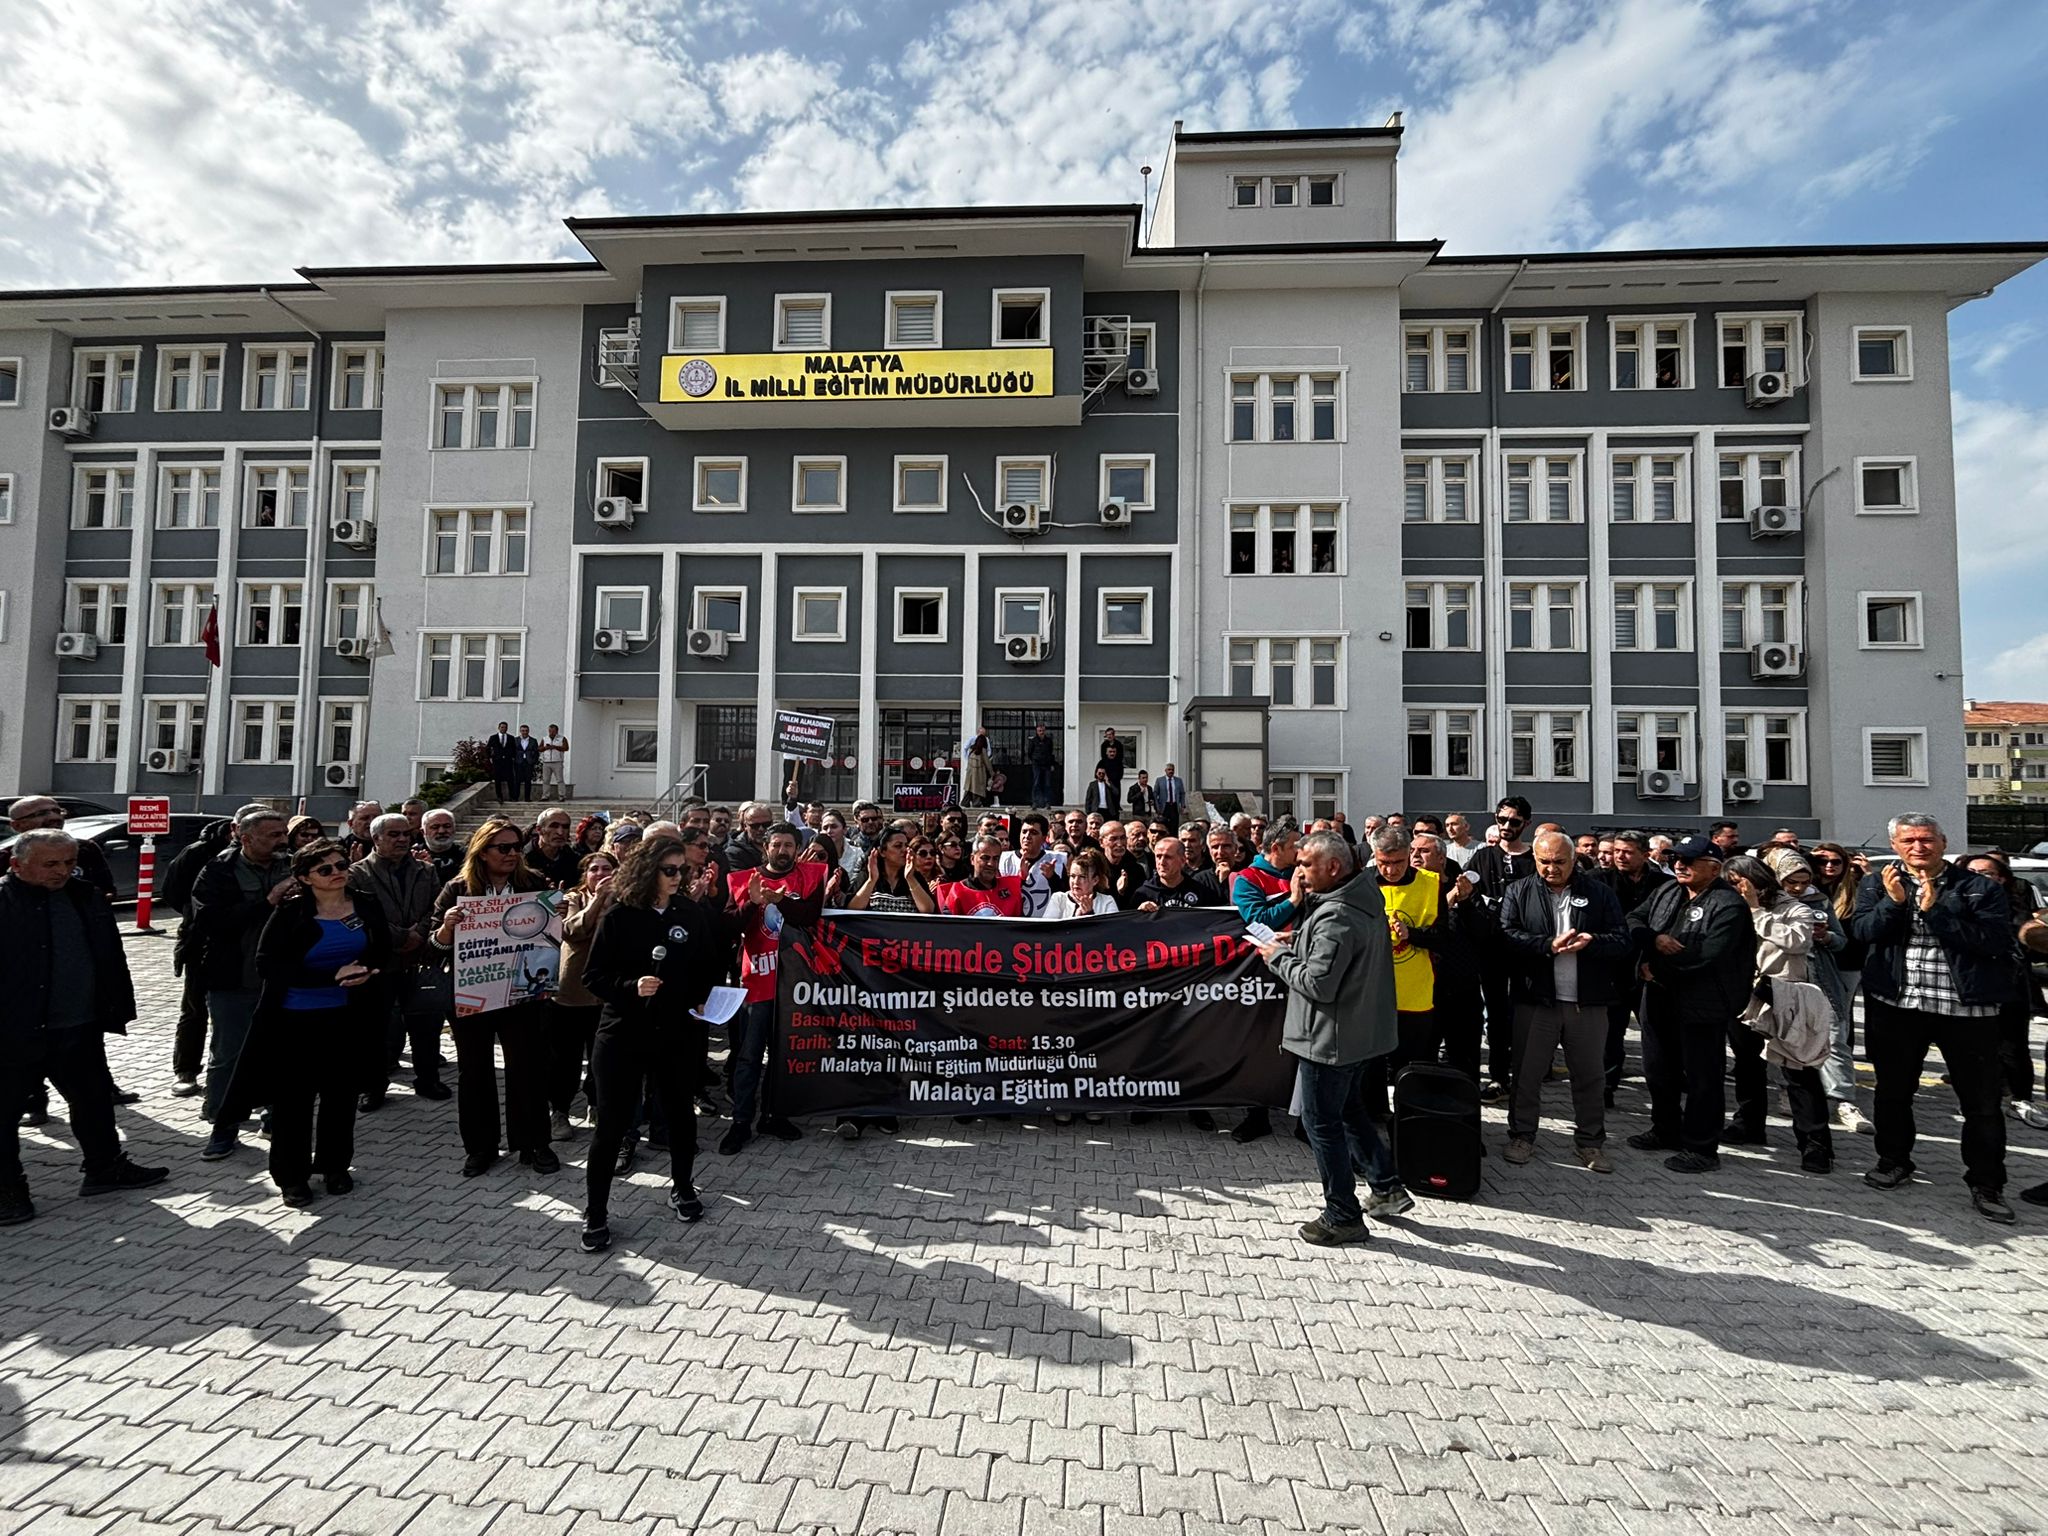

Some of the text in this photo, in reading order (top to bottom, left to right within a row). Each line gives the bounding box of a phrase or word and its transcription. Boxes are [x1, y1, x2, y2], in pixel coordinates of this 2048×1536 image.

[805, 354, 904, 374] MALATYA
[725, 370, 1034, 397] İL MİLLİ EĞİTİM MÜDÜRLÜĞÜ
[779, 714, 799, 724] ÖNLEM
[779, 732, 790, 741] BİZ
[787, 725, 818, 736] BEDELİNİ
[895, 786, 923, 795] ARTIK
[461, 900, 483, 908] TEK
[506, 917, 536, 927] OLAN
[458, 937, 499, 951] EĞİTİM
[458, 943, 535, 963] ÇALIŞANLARI
[861, 937, 1003, 974] Eğitimde
[1011, 942, 1137, 982] Şiddete
[1146, 940, 1206, 969] Dur
[458, 962, 506, 977] YALNIZ
[793, 976, 1284, 1013] Okullarımızı şiddete teslim etmeyeceğiz.
[791, 1012, 835, 1028] Basın
[789, 1034, 1075, 1057] Tarih: 15 Nisan Çarşamba Saat: 15.30
[787, 1051, 1097, 1078] Yer: Malatya İl Milli Eğitim Müdürlüğü Önü
[909, 1075, 1180, 1106] Malatya Eğitim Platformu
